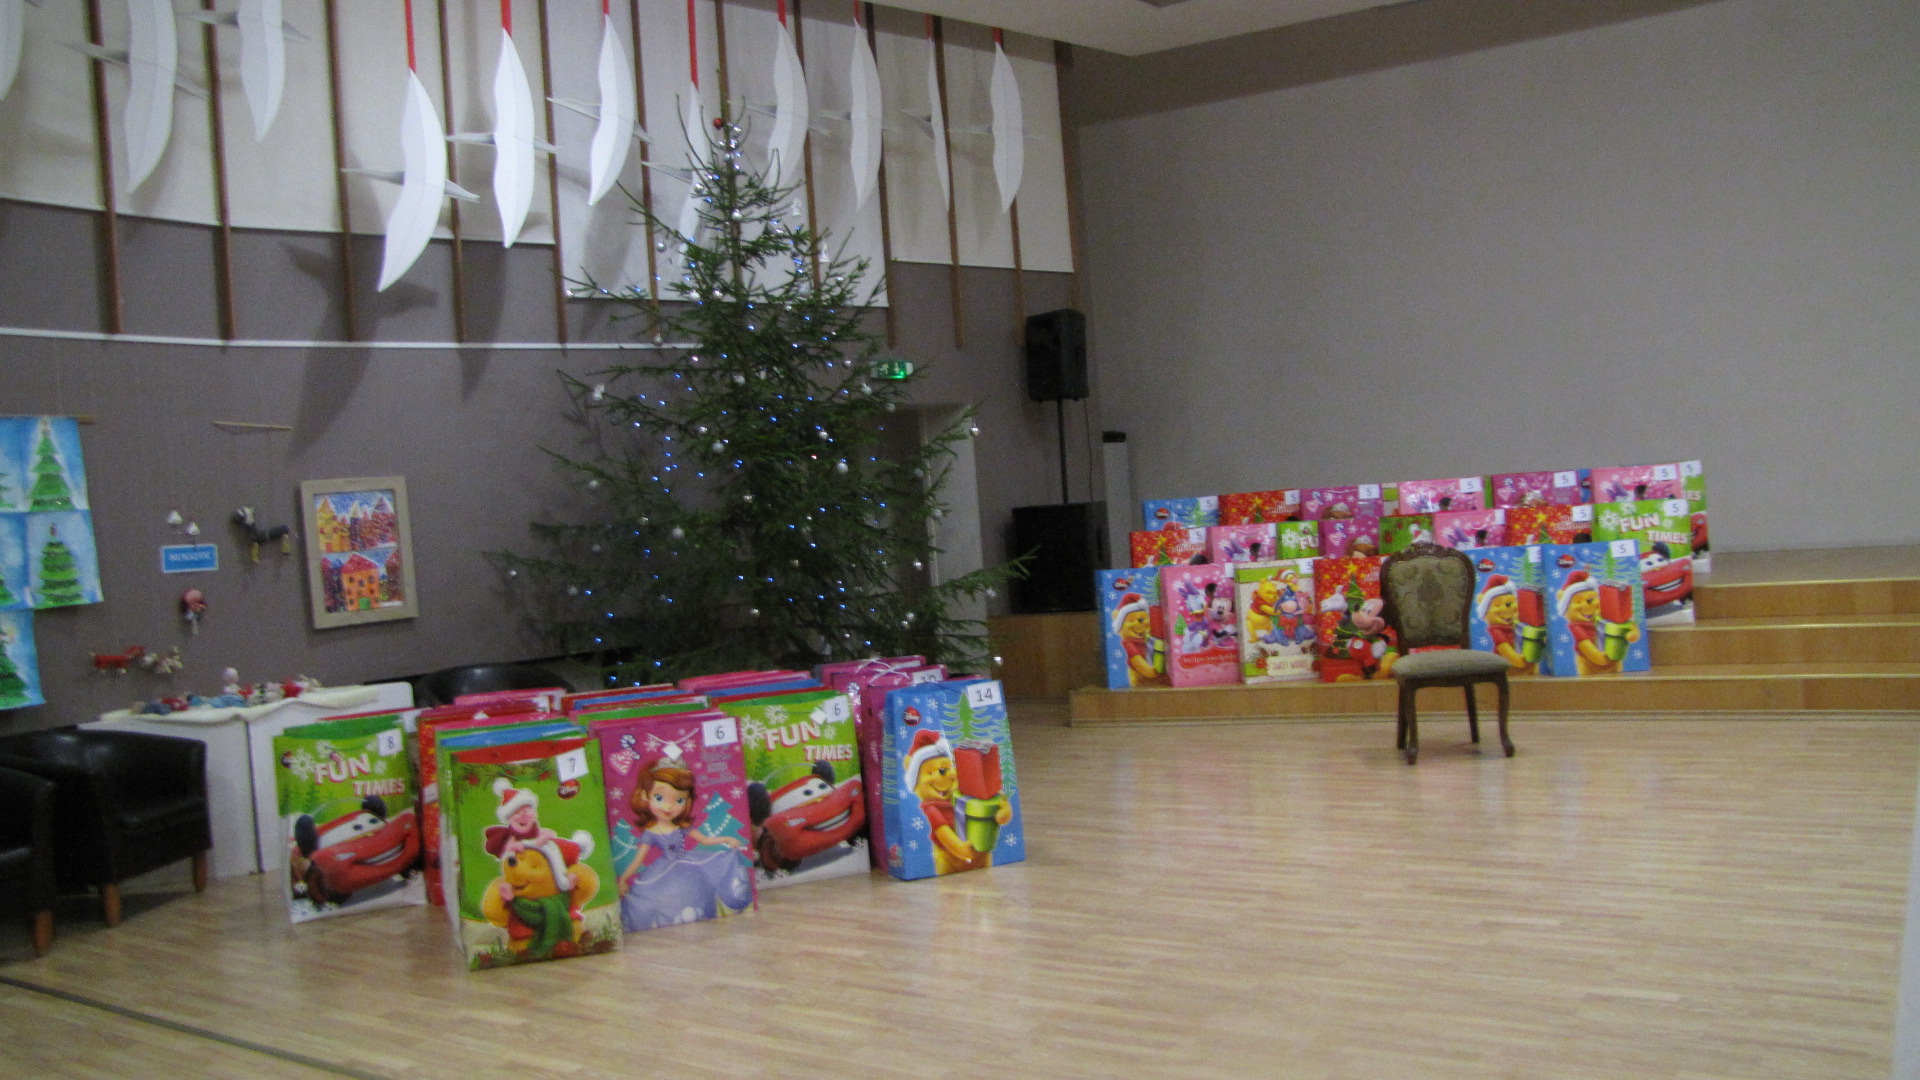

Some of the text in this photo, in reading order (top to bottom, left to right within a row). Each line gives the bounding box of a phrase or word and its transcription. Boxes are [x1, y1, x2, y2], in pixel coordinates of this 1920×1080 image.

[1467, 481, 1474, 490] 5
[1562, 476, 1569, 484] 5
[1366, 489, 1372, 497] 5
[1580, 508, 1587, 518] 5
[1672, 504, 1679, 513] 5
[1619, 513, 1660, 534] FUN
[1647, 530, 1689, 544] TIMES
[1619, 544, 1627, 554] 5
[975, 688, 993, 702] 14
[834, 703, 841, 716] 6
[716, 726, 725, 740] 6
[765, 720, 821, 752] FUN
[387, 735, 396, 749] 8
[804, 744, 853, 762] TIMES
[314, 752, 371, 785] FUN
[567, 757, 576, 773] 7
[353, 778, 406, 797] TIMES
